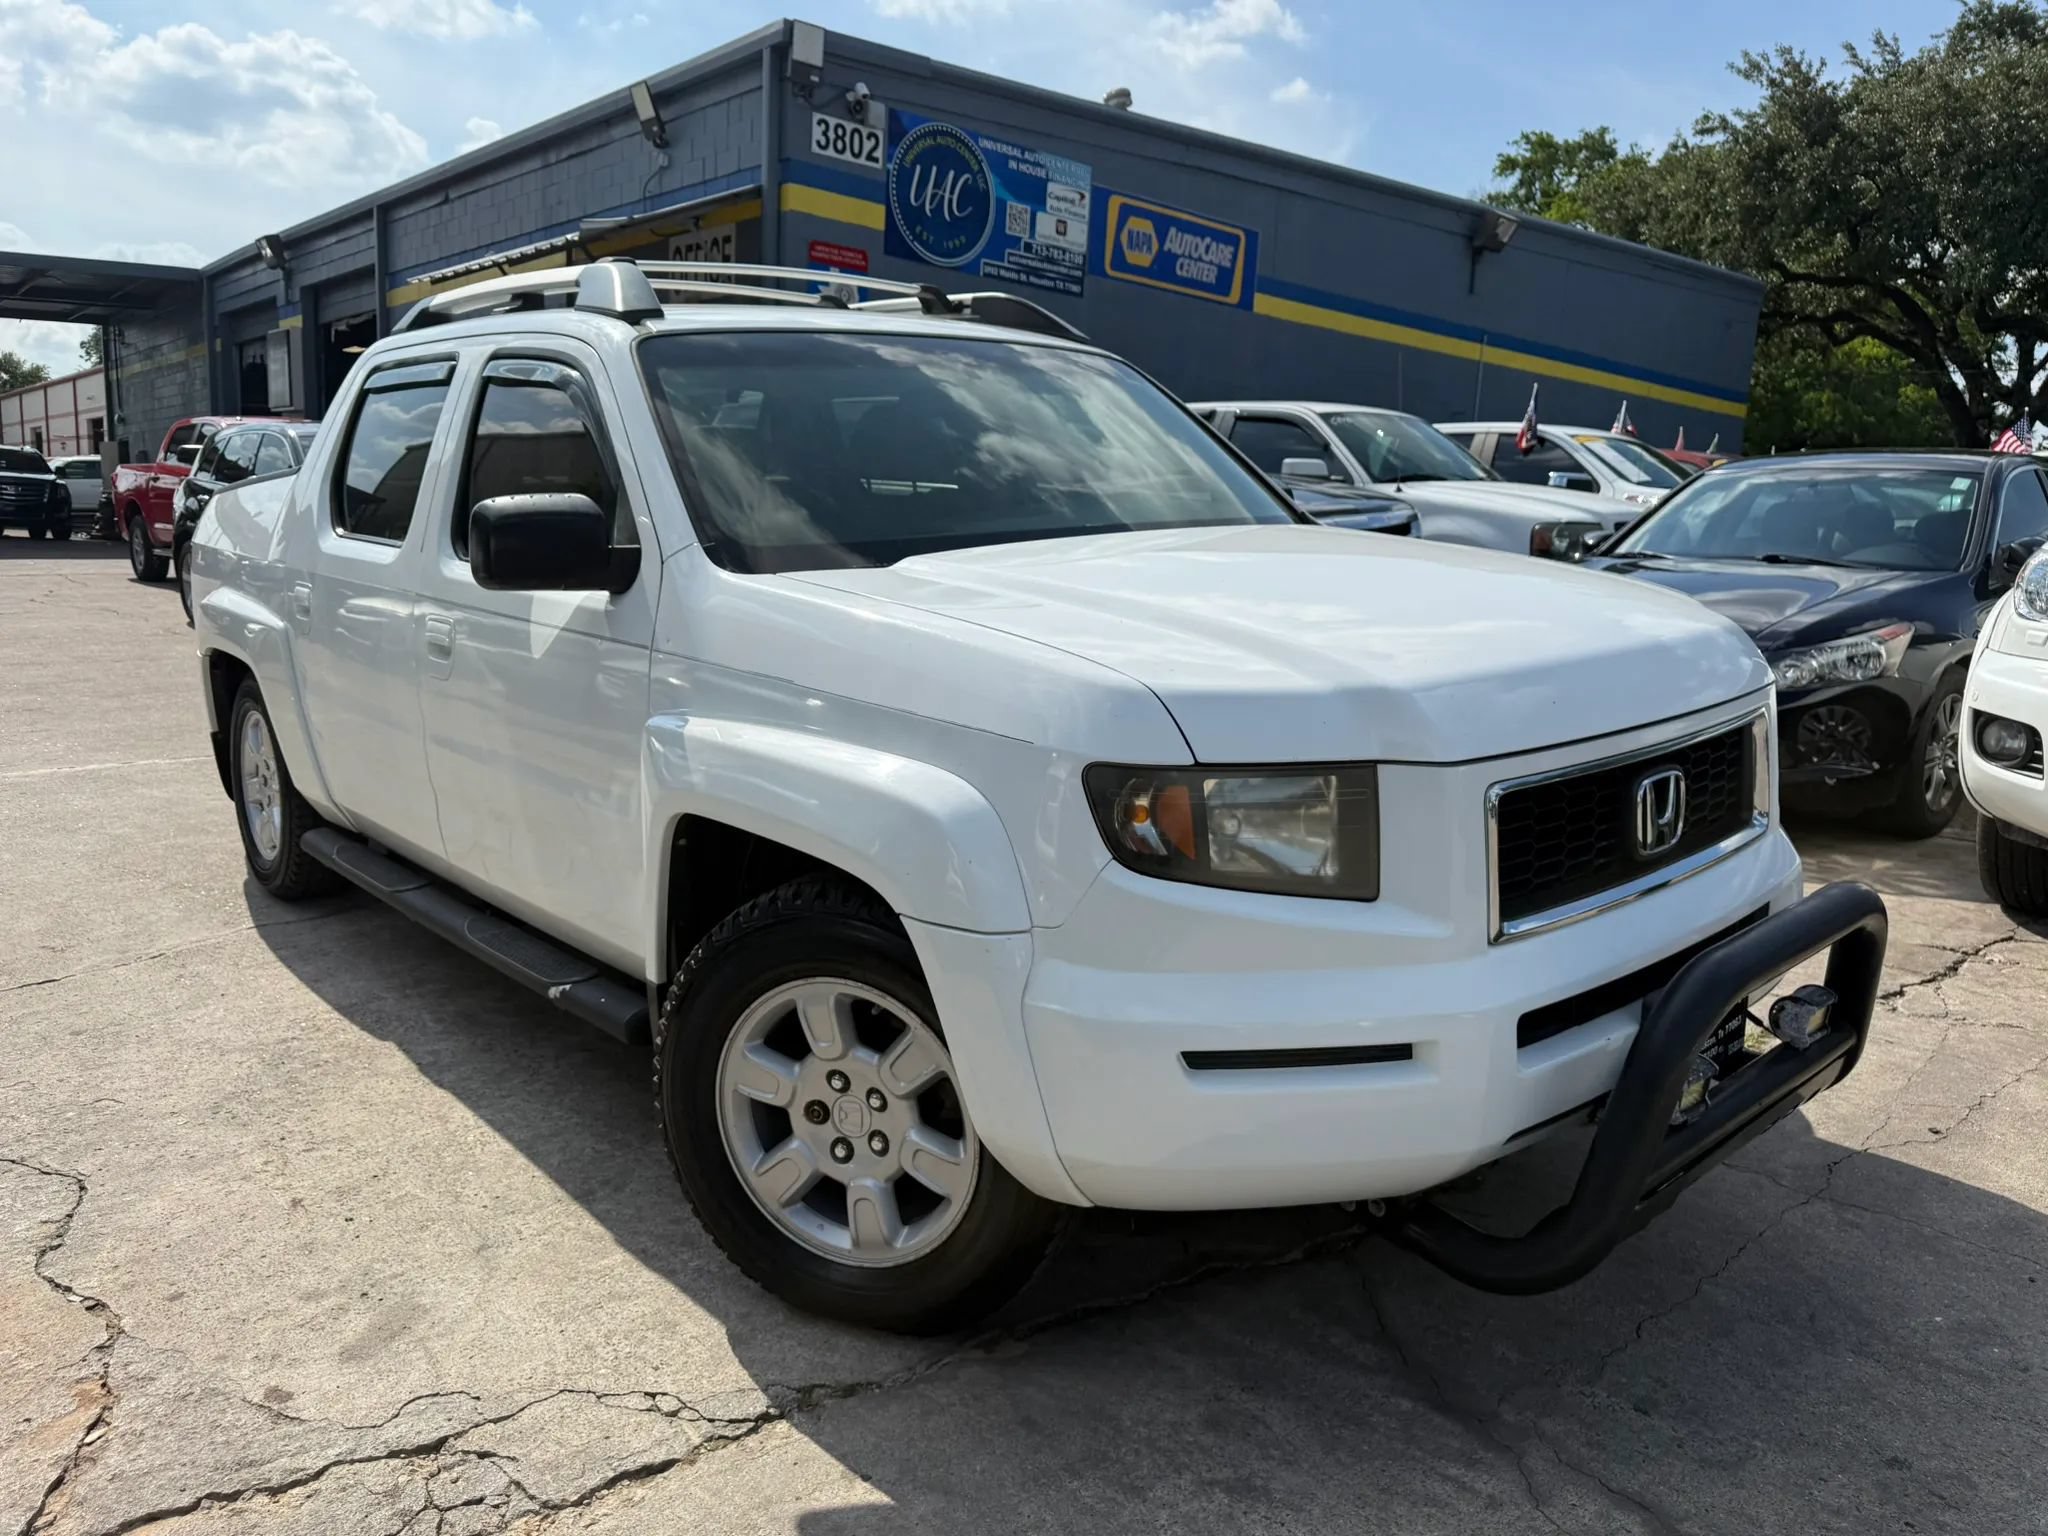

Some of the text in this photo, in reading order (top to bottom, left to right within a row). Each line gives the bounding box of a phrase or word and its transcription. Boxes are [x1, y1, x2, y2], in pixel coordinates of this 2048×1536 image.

[816, 118, 880, 164] 3802
[978, 136, 1022, 158] UNIVERSAL
[1023, 151, 1045, 165] AUTO
[1008, 160, 1018, 171] IN
[1019, 162, 1047, 179] HOUSE
[909, 164, 973, 222] UAC
[1128, 230, 1153, 256] NAPA
[1175, 257, 1218, 285] CENTER
